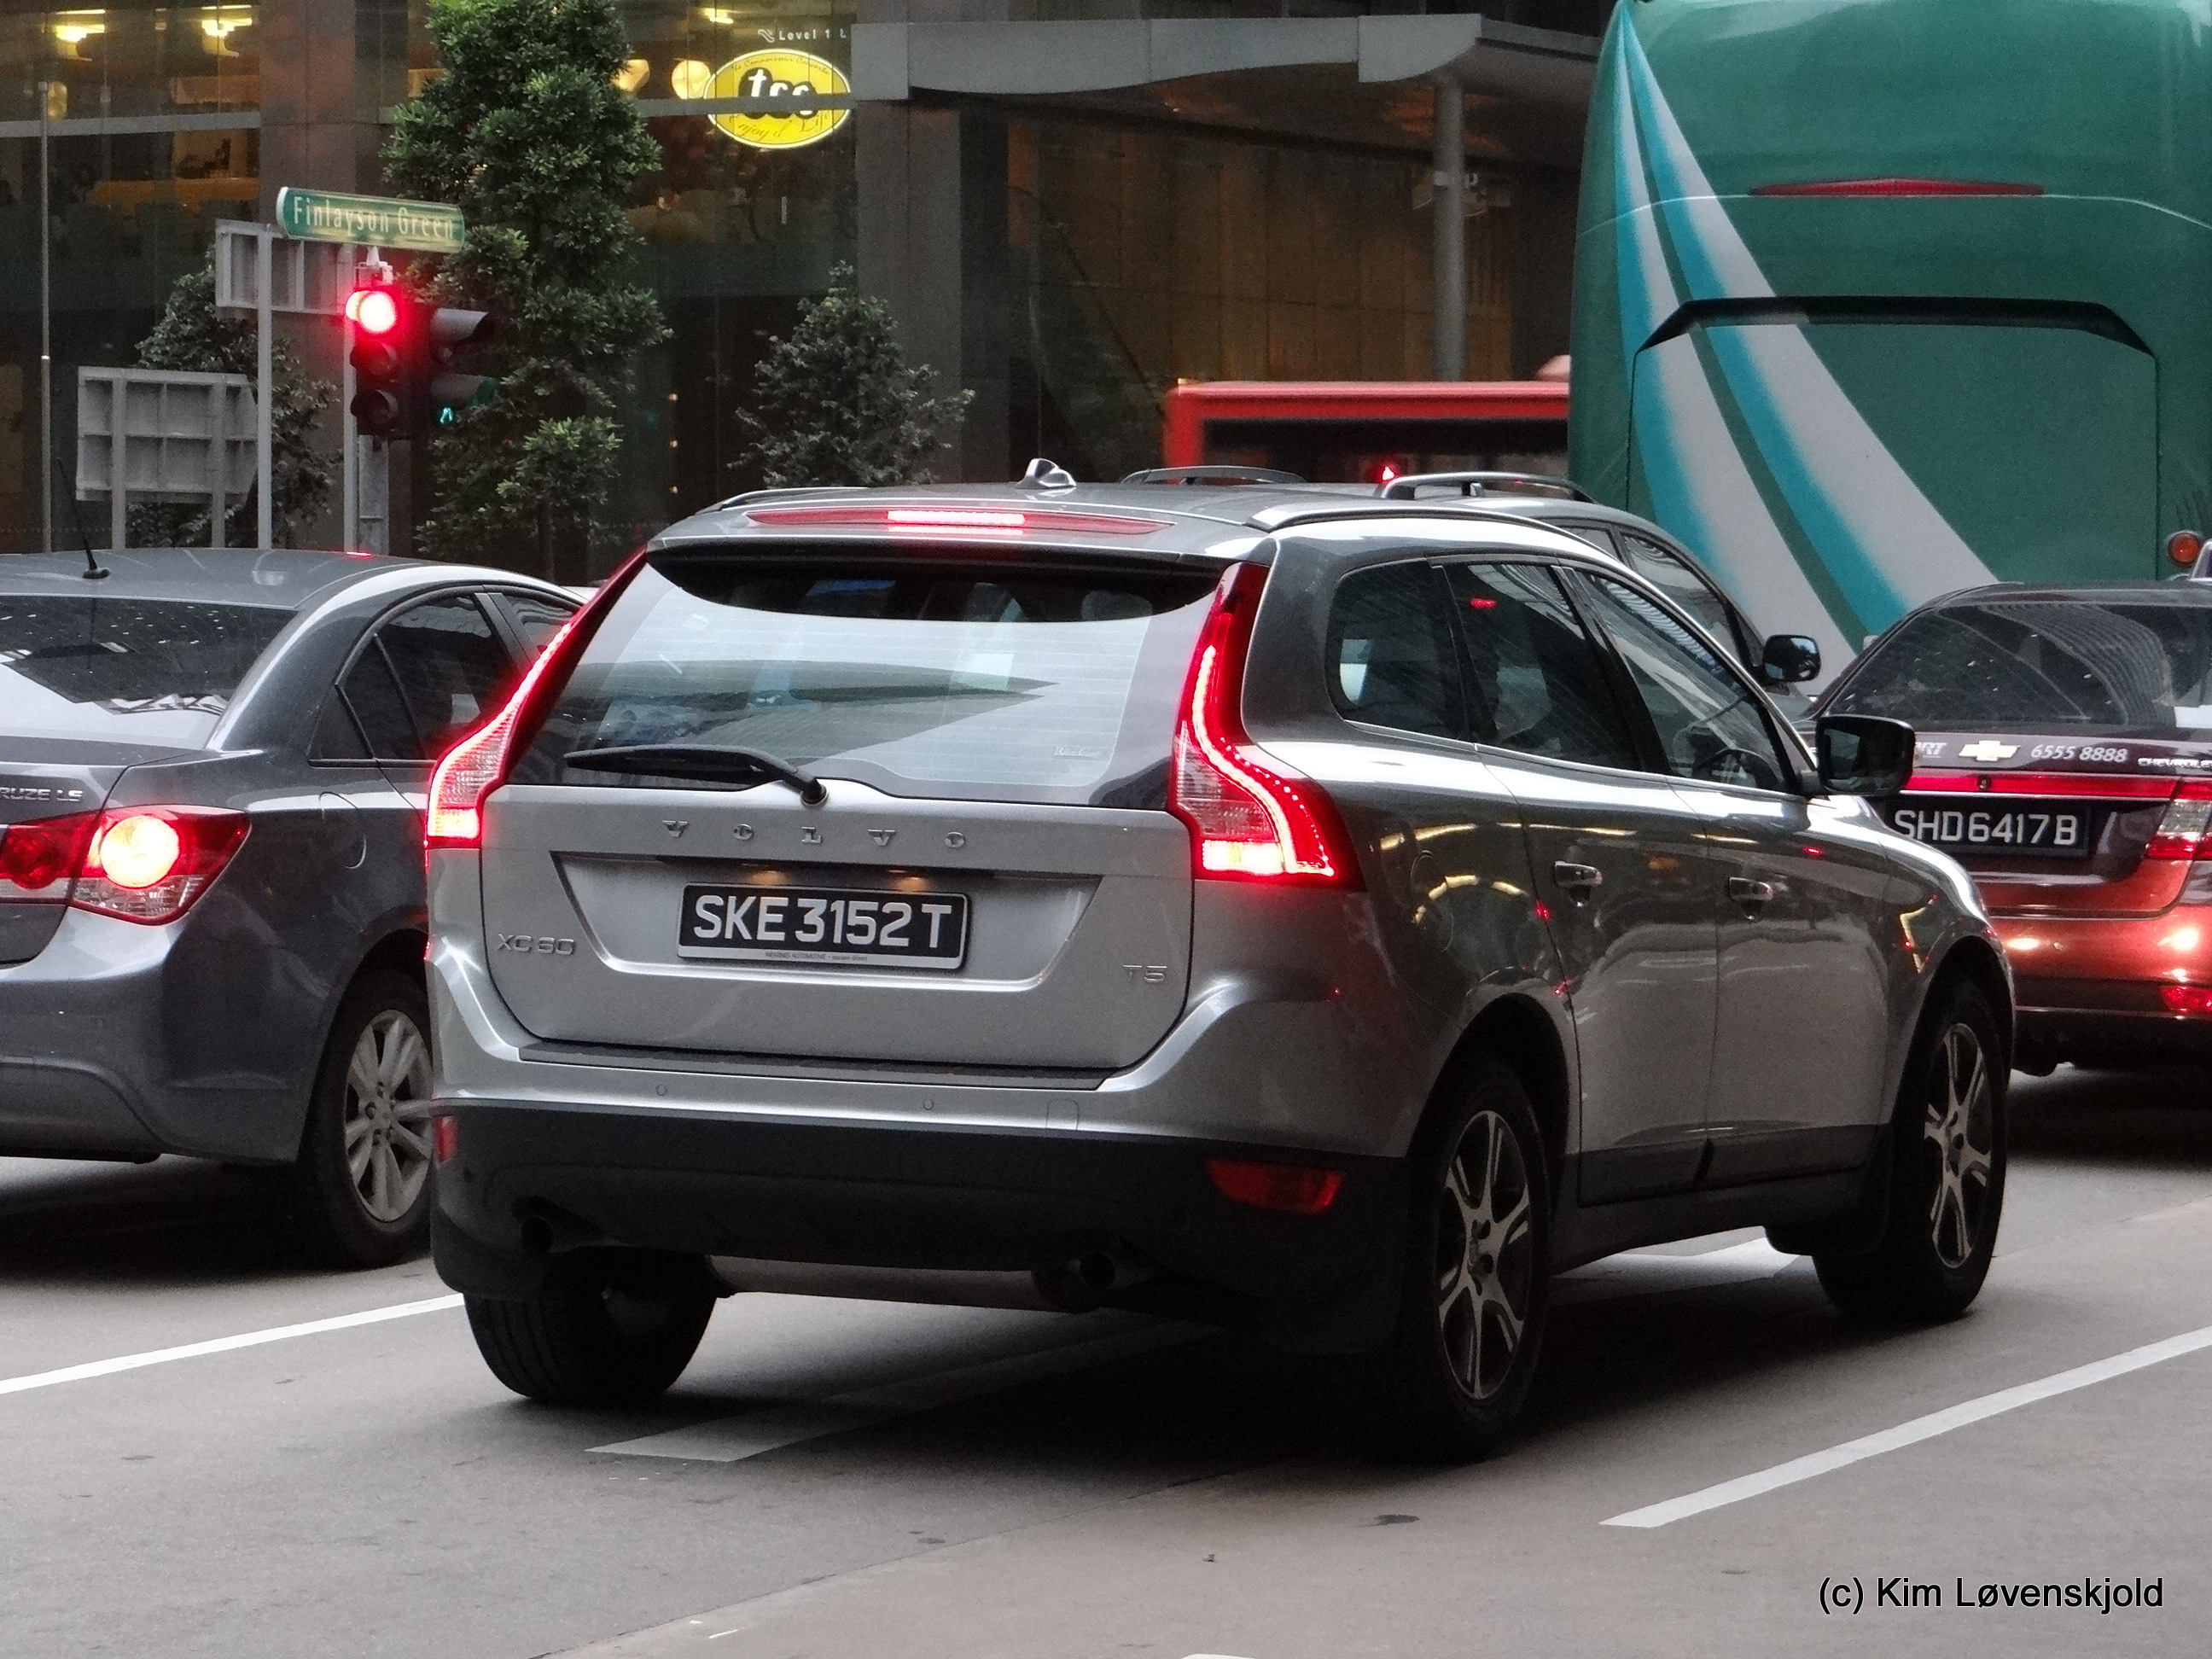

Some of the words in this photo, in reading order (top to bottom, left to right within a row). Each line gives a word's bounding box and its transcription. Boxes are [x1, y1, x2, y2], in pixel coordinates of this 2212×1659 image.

[778, 28, 817, 40] Level
[293, 196, 389, 236] Finlayson
[397, 207, 454, 239] Green
[2031, 744, 2076, 760] 6555
[2079, 747, 2128, 762] 8888
[56, 789, 83, 802] LS
[662, 819, 966, 848] VOLVO
[1122, 964, 1167, 983] T5
